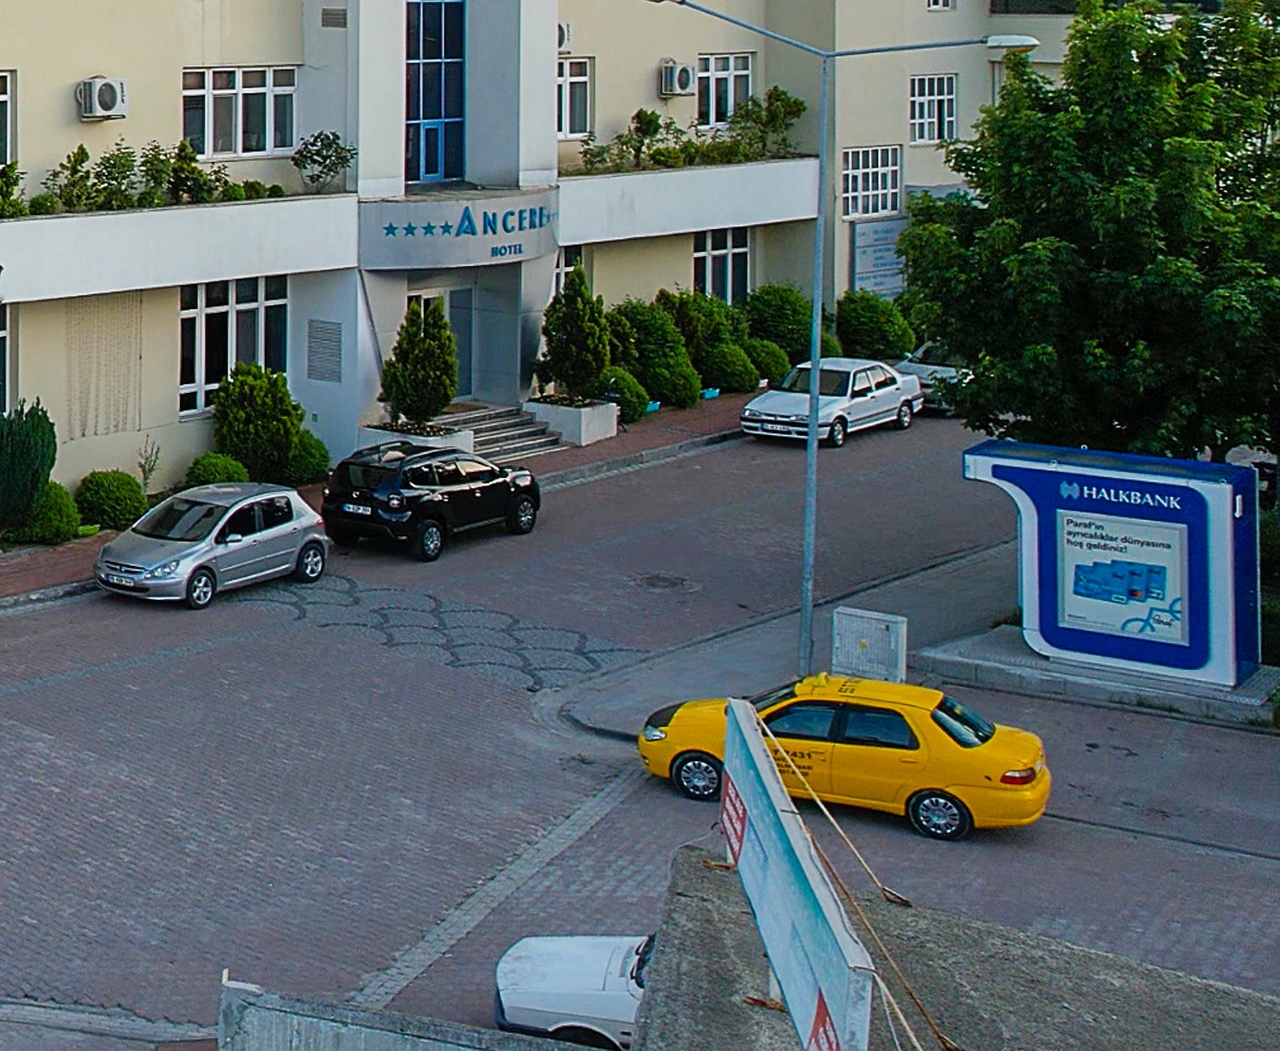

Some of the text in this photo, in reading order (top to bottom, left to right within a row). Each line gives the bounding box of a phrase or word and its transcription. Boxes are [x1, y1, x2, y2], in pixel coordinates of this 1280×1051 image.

[455, 206, 547, 238] ANCERE
[490, 243, 524, 258] HOTEL
[1083, 485, 1181, 510] HALKBANK
[1066, 538, 1128, 554] hoş geldiniz!
[1120, 536, 1172, 550] dünyasına
